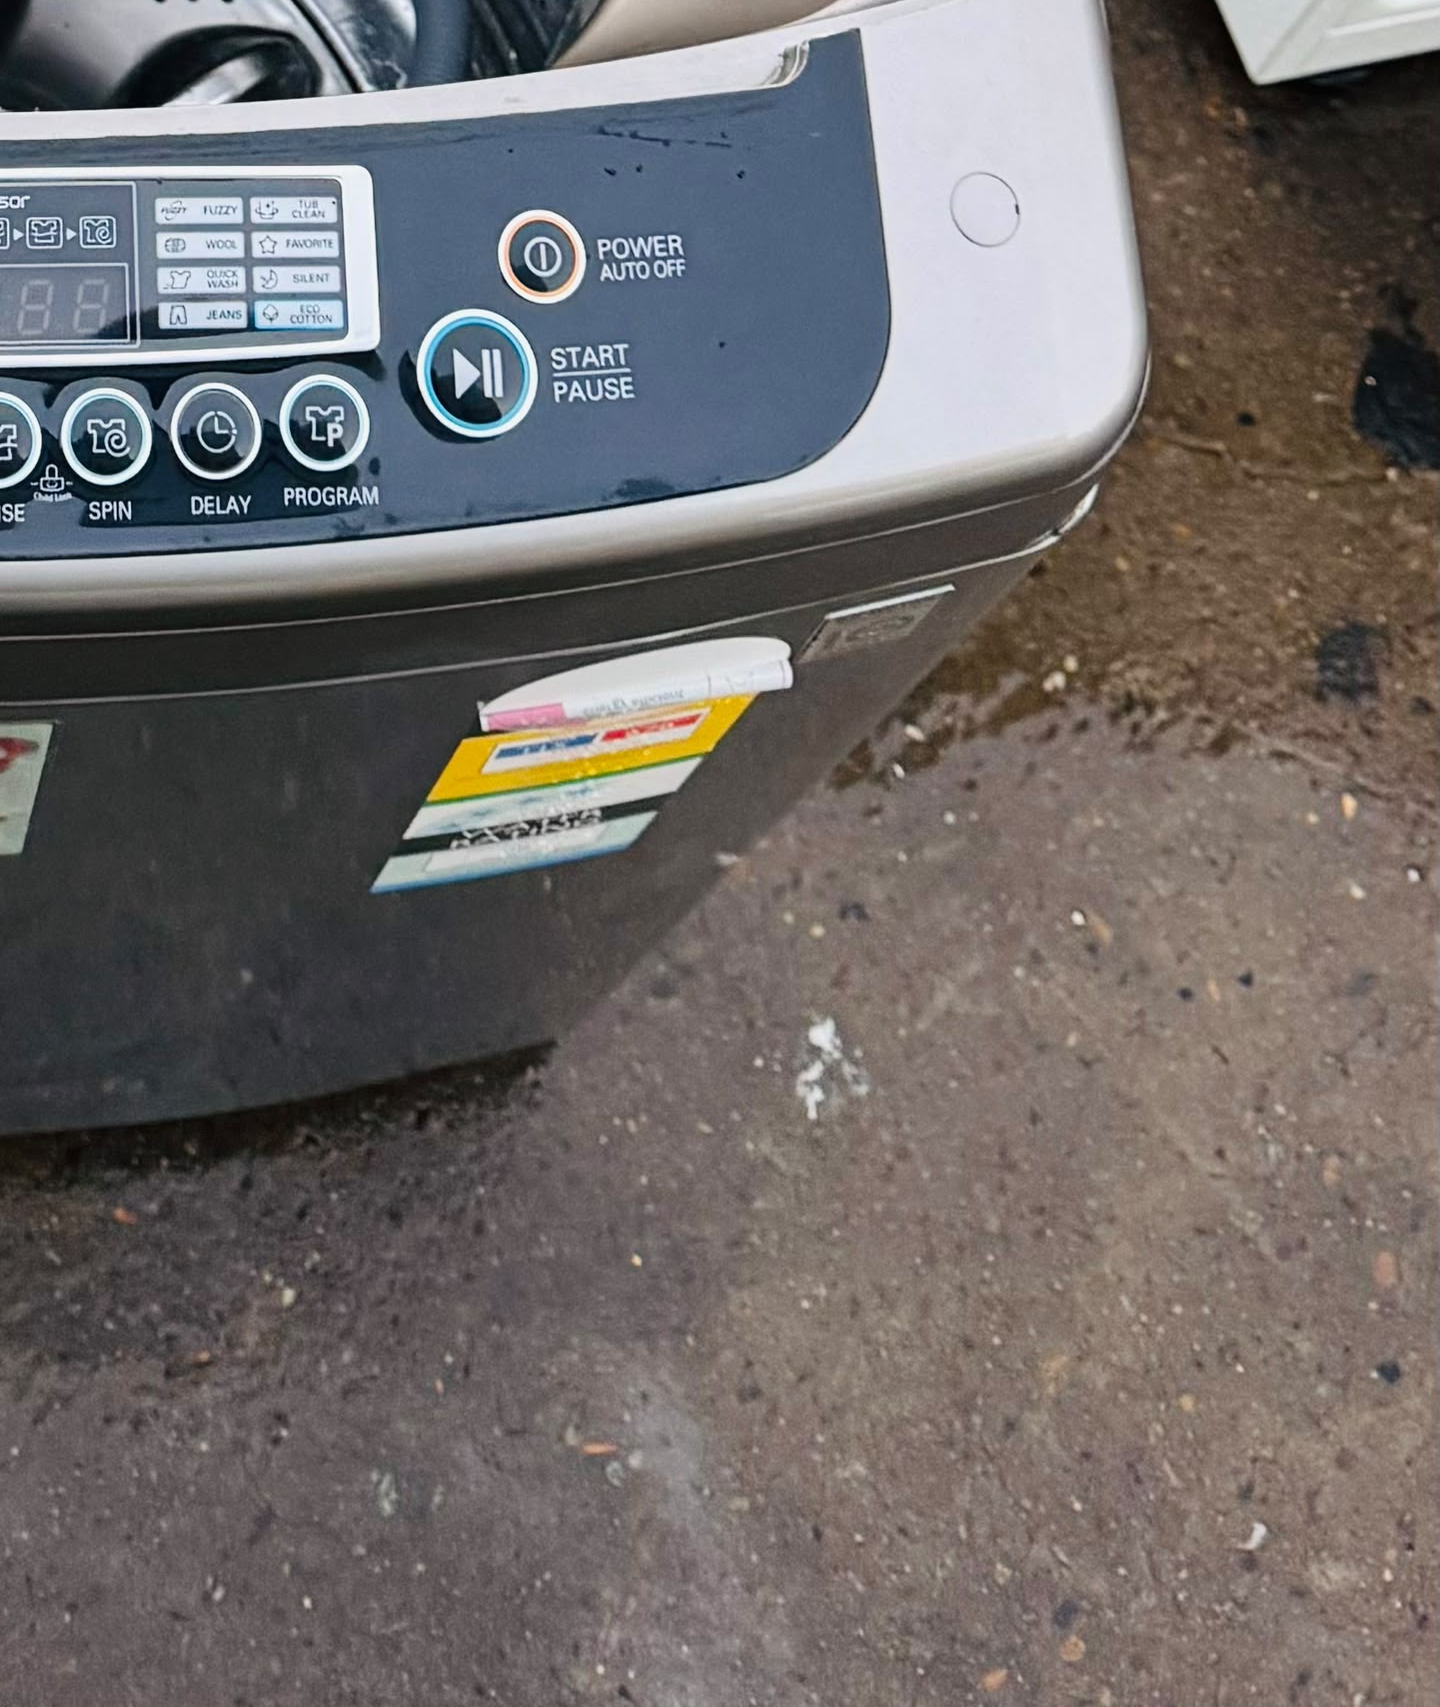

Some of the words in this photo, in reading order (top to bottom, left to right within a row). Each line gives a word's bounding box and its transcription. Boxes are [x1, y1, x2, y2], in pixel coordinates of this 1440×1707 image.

[203, 204, 239, 216] FUZZY
[298, 199, 319, 209] TUB
[291, 209, 326, 219] CLEAN
[205, 239, 239, 250] WOOL
[285, 238, 334, 249] FAVORITE
[596, 234, 685, 260] POWER
[206, 269, 239, 279] QUICK
[599, 260, 650, 282] AUTO
[653, 258, 686, 279] OFF
[207, 278, 239, 289] WASH
[292, 272, 331, 284] SILENT
[206, 308, 243, 321] JEANS
[299, 303, 321, 315] ECO
[289, 313, 334, 325] COTTON
[549, 342, 630, 370] START
[552, 376, 636, 403] PAUSE
[283, 486, 380, 508] PROGRAM
[88, 501, 133, 522] SPIN
[191, 495, 253, 516] DELAY
